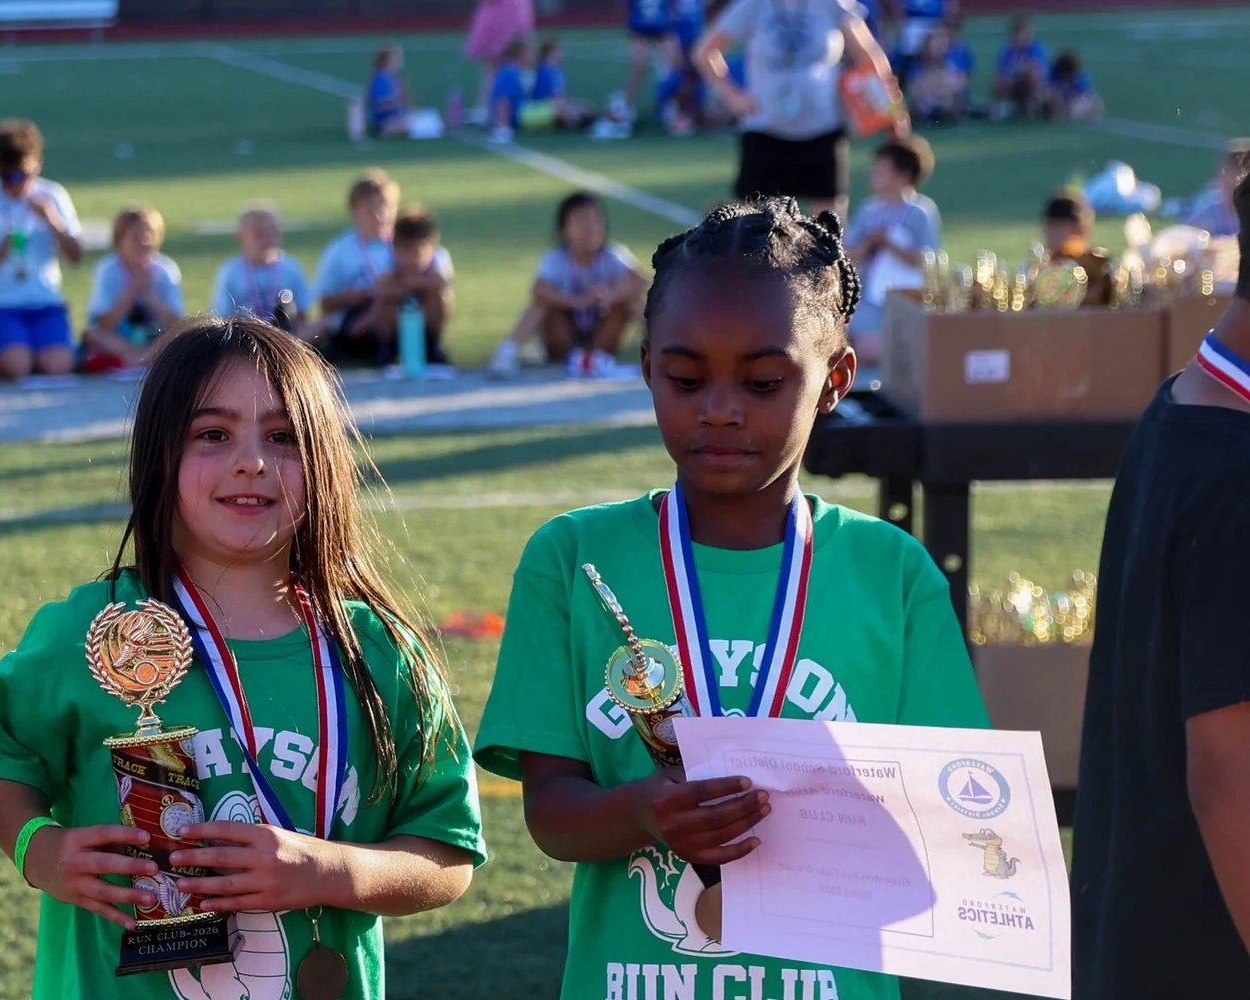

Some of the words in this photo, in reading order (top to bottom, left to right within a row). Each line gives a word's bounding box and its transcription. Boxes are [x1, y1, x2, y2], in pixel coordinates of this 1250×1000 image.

[113, 755, 147, 775] TRACK
[128, 935, 152, 945] RUN
[157, 926, 219, 941] CLUB-2026
[138, 938, 207, 955] CHAMPION
